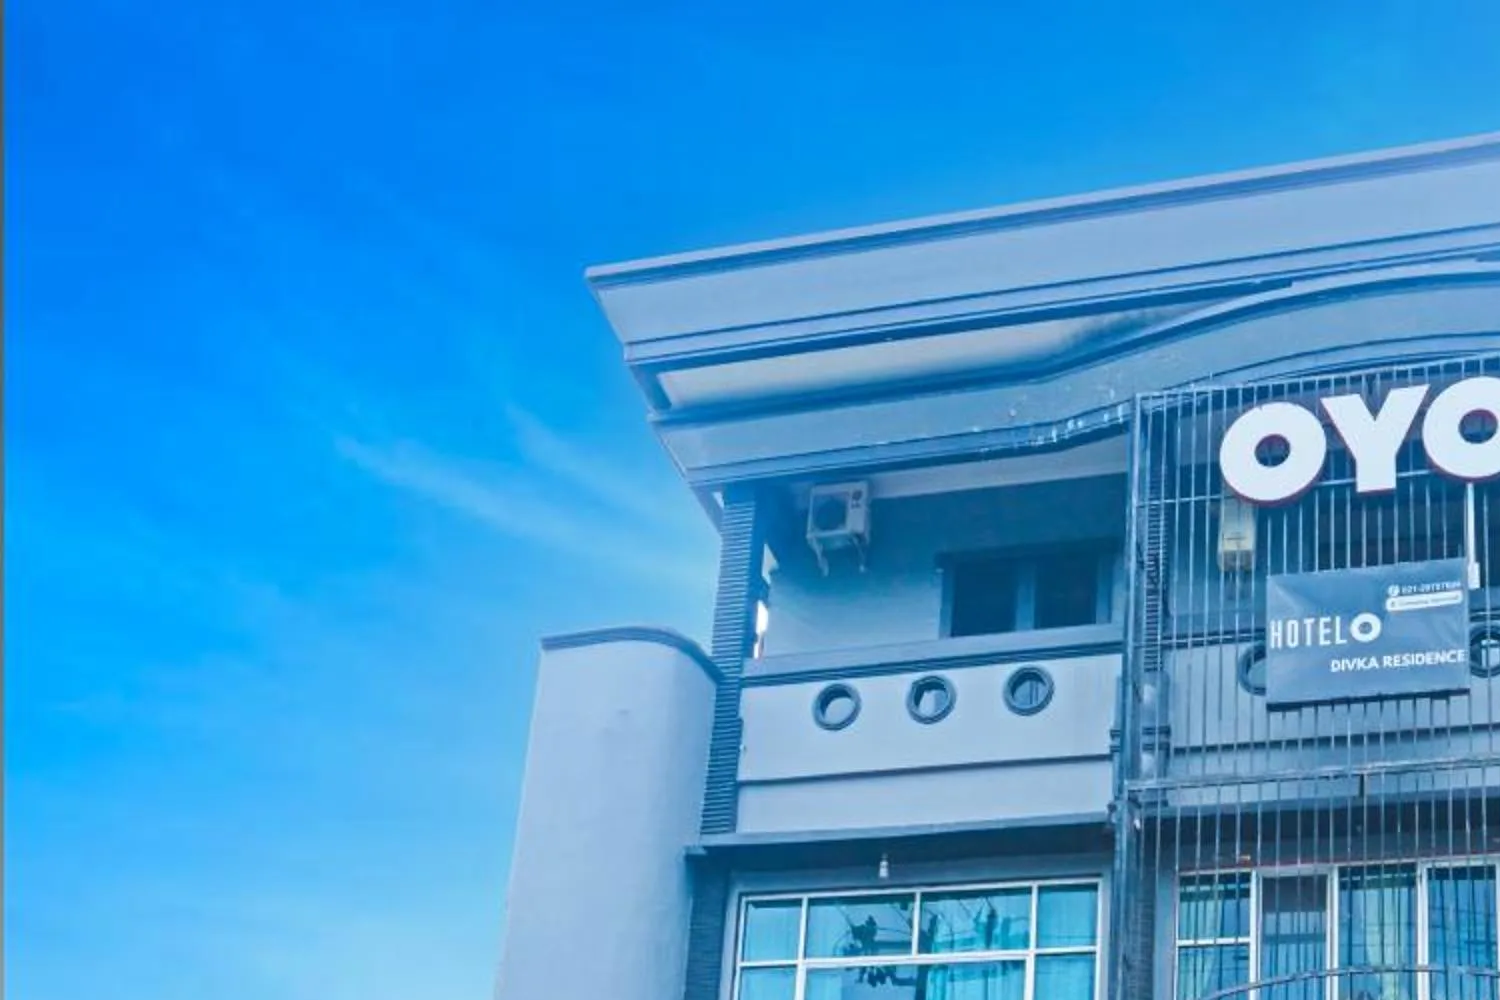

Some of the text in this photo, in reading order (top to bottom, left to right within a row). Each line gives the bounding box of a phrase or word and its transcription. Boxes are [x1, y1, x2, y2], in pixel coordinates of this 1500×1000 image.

[1269, 616, 1348, 649] HOTEL
[1331, 649, 1467, 672] DIVKA RESIDENCE
